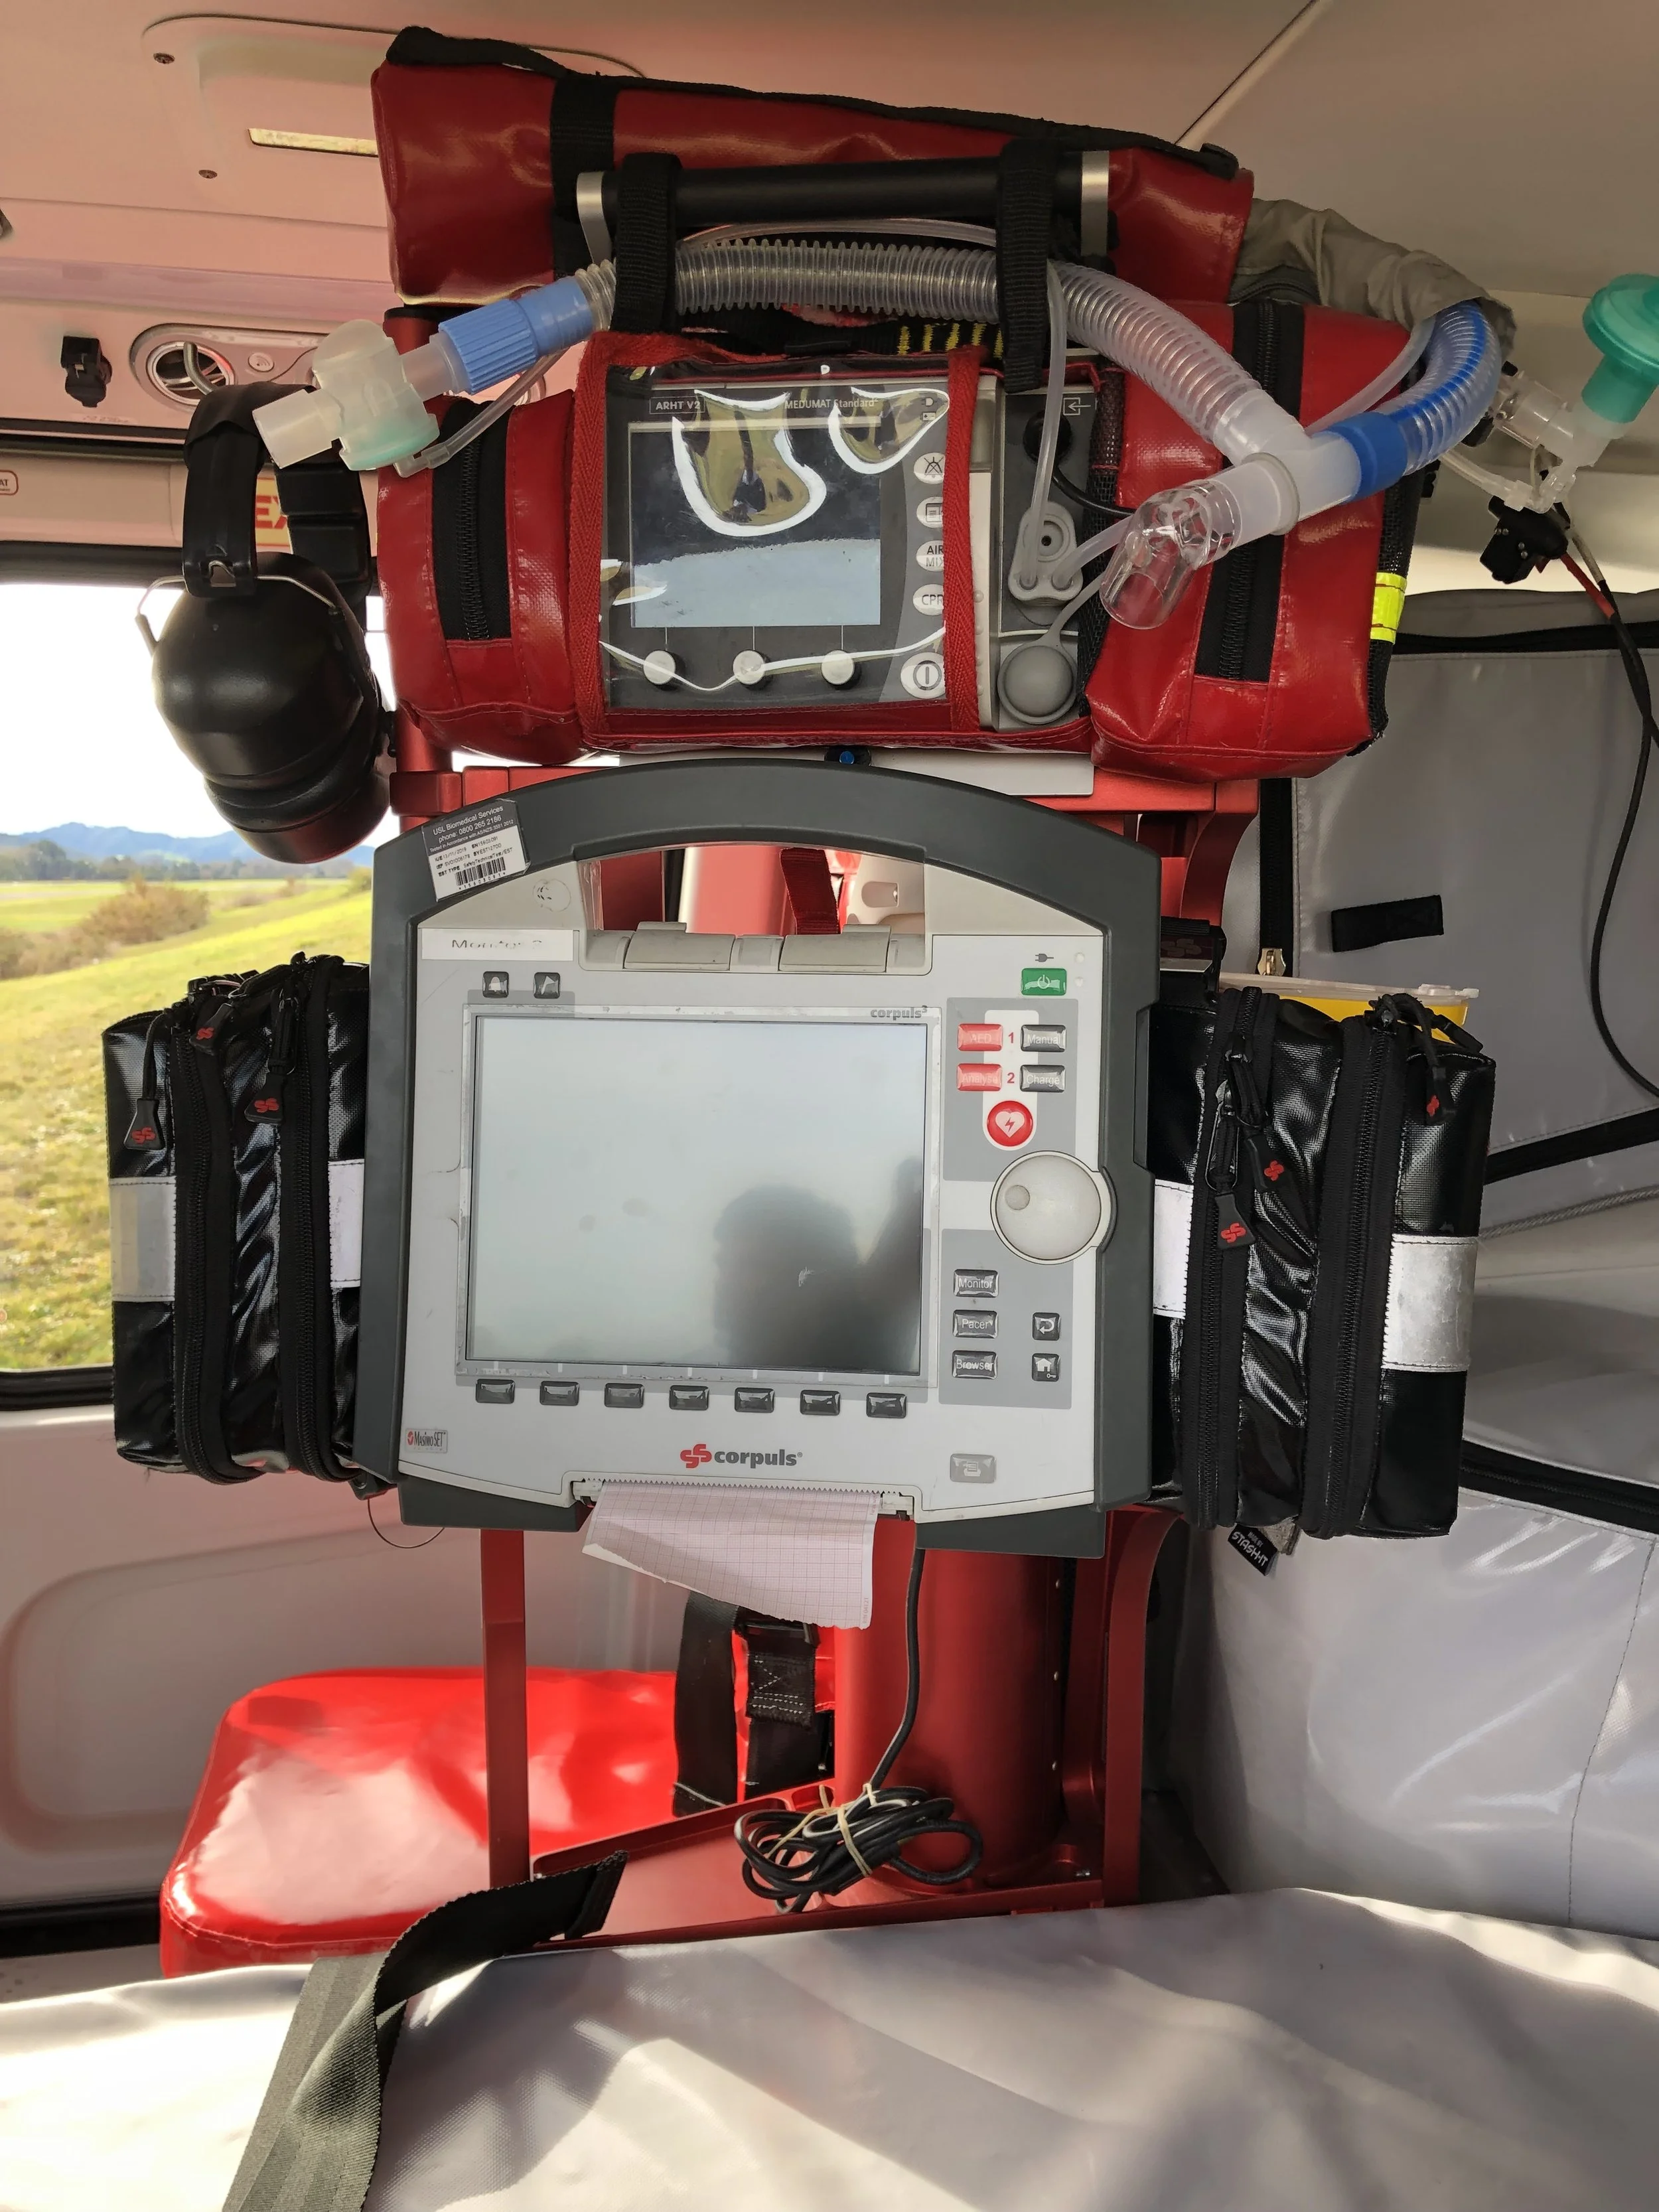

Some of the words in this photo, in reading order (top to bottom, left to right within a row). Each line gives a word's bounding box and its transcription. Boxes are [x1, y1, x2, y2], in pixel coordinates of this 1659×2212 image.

[656, 401, 684, 410] ARHT
[686, 400, 701, 409] V2
[784, 399, 831, 409] MEDUMAT
[927, 545, 944, 555] AIR
[921, 594, 944, 605] CPR
[433, 825, 446, 836] USL
[446, 814, 477, 830] Biomedical
[478, 806, 504, 819] Services
[439, 830, 459, 844] phone:
[459, 824, 474, 835] 0800
[474, 820, 486, 830] 265
[971, 1033, 992, 1043] AED
[1008, 1032, 1015, 1044] 1
[1027, 1033, 1060, 1045] Manual
[962, 1072, 999, 1085] Analyse
[1007, 1072, 1015, 1084] 2
[1026, 1074, 1060, 1086] Charge
[958, 1278, 993, 1289] Monitor
[962, 1319, 989, 1329] Pacer
[956, 1359, 994, 1371] Browser
